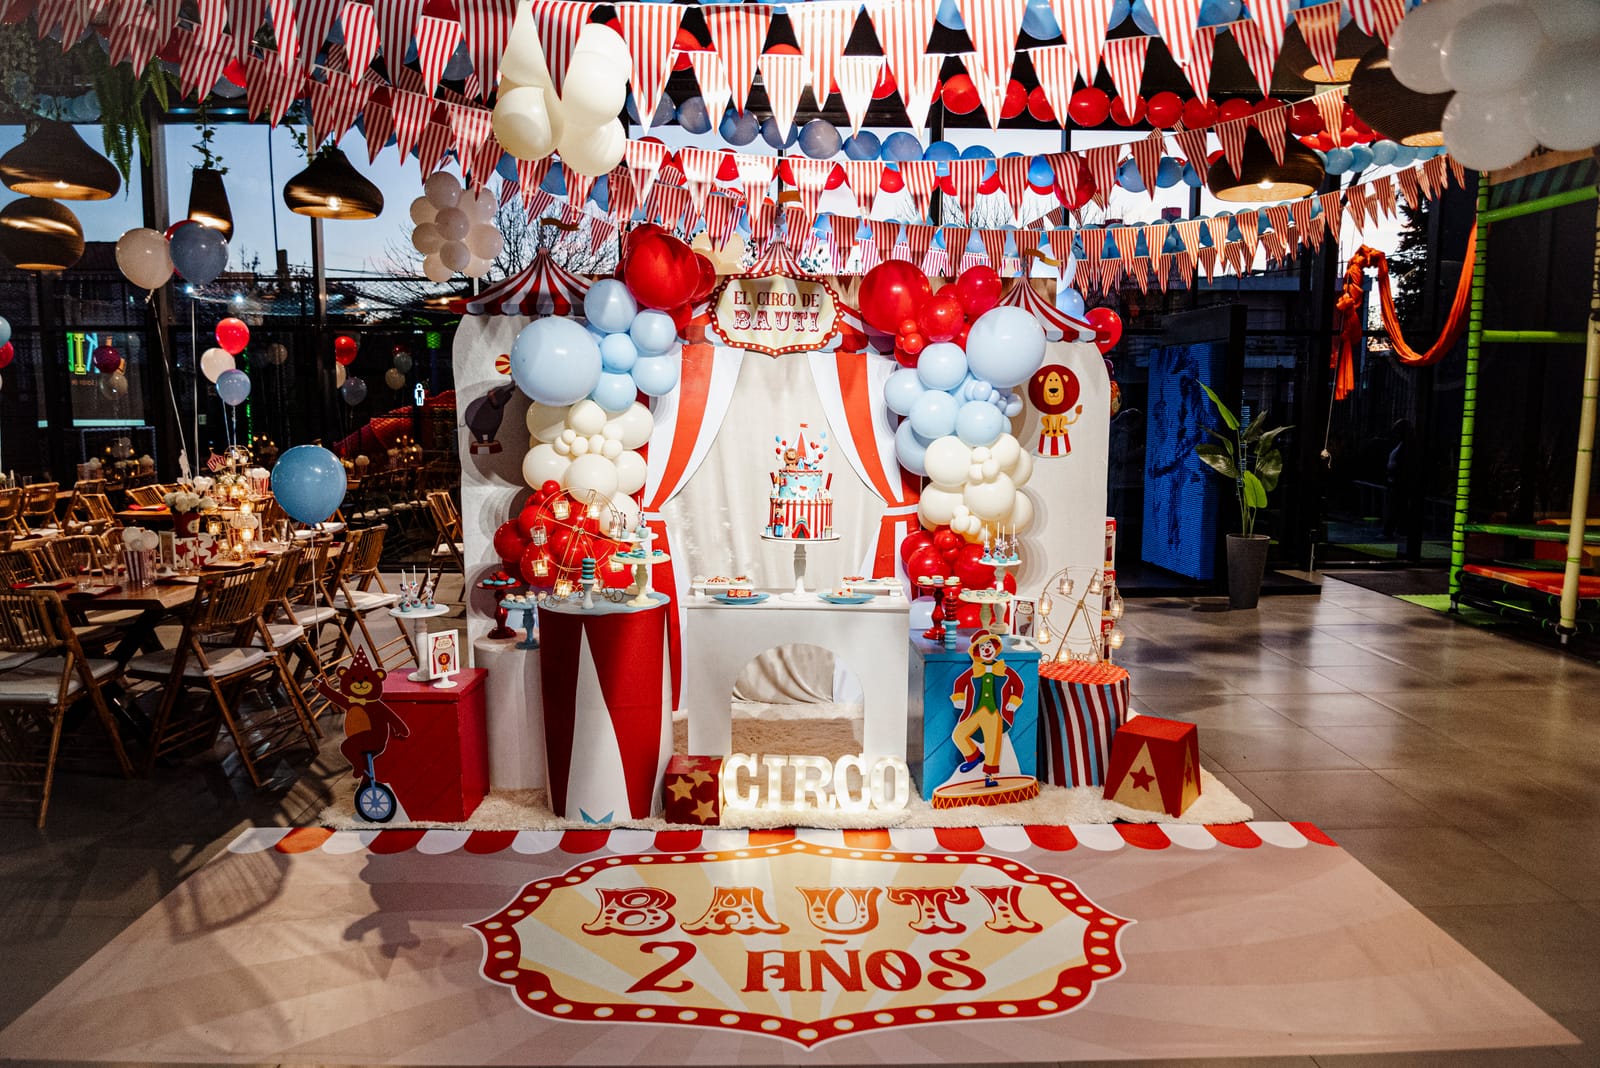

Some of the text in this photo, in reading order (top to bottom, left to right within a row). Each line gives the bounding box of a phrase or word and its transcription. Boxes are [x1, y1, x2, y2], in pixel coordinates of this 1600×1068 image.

[733, 290, 820, 308] EL CIRCO DE
[733, 309, 820, 333] BAUTI
[722, 752, 910, 812] CIRCO
[581, 886, 1044, 937] BAUTI
[624, 938, 987, 994] 2 AÑOS
